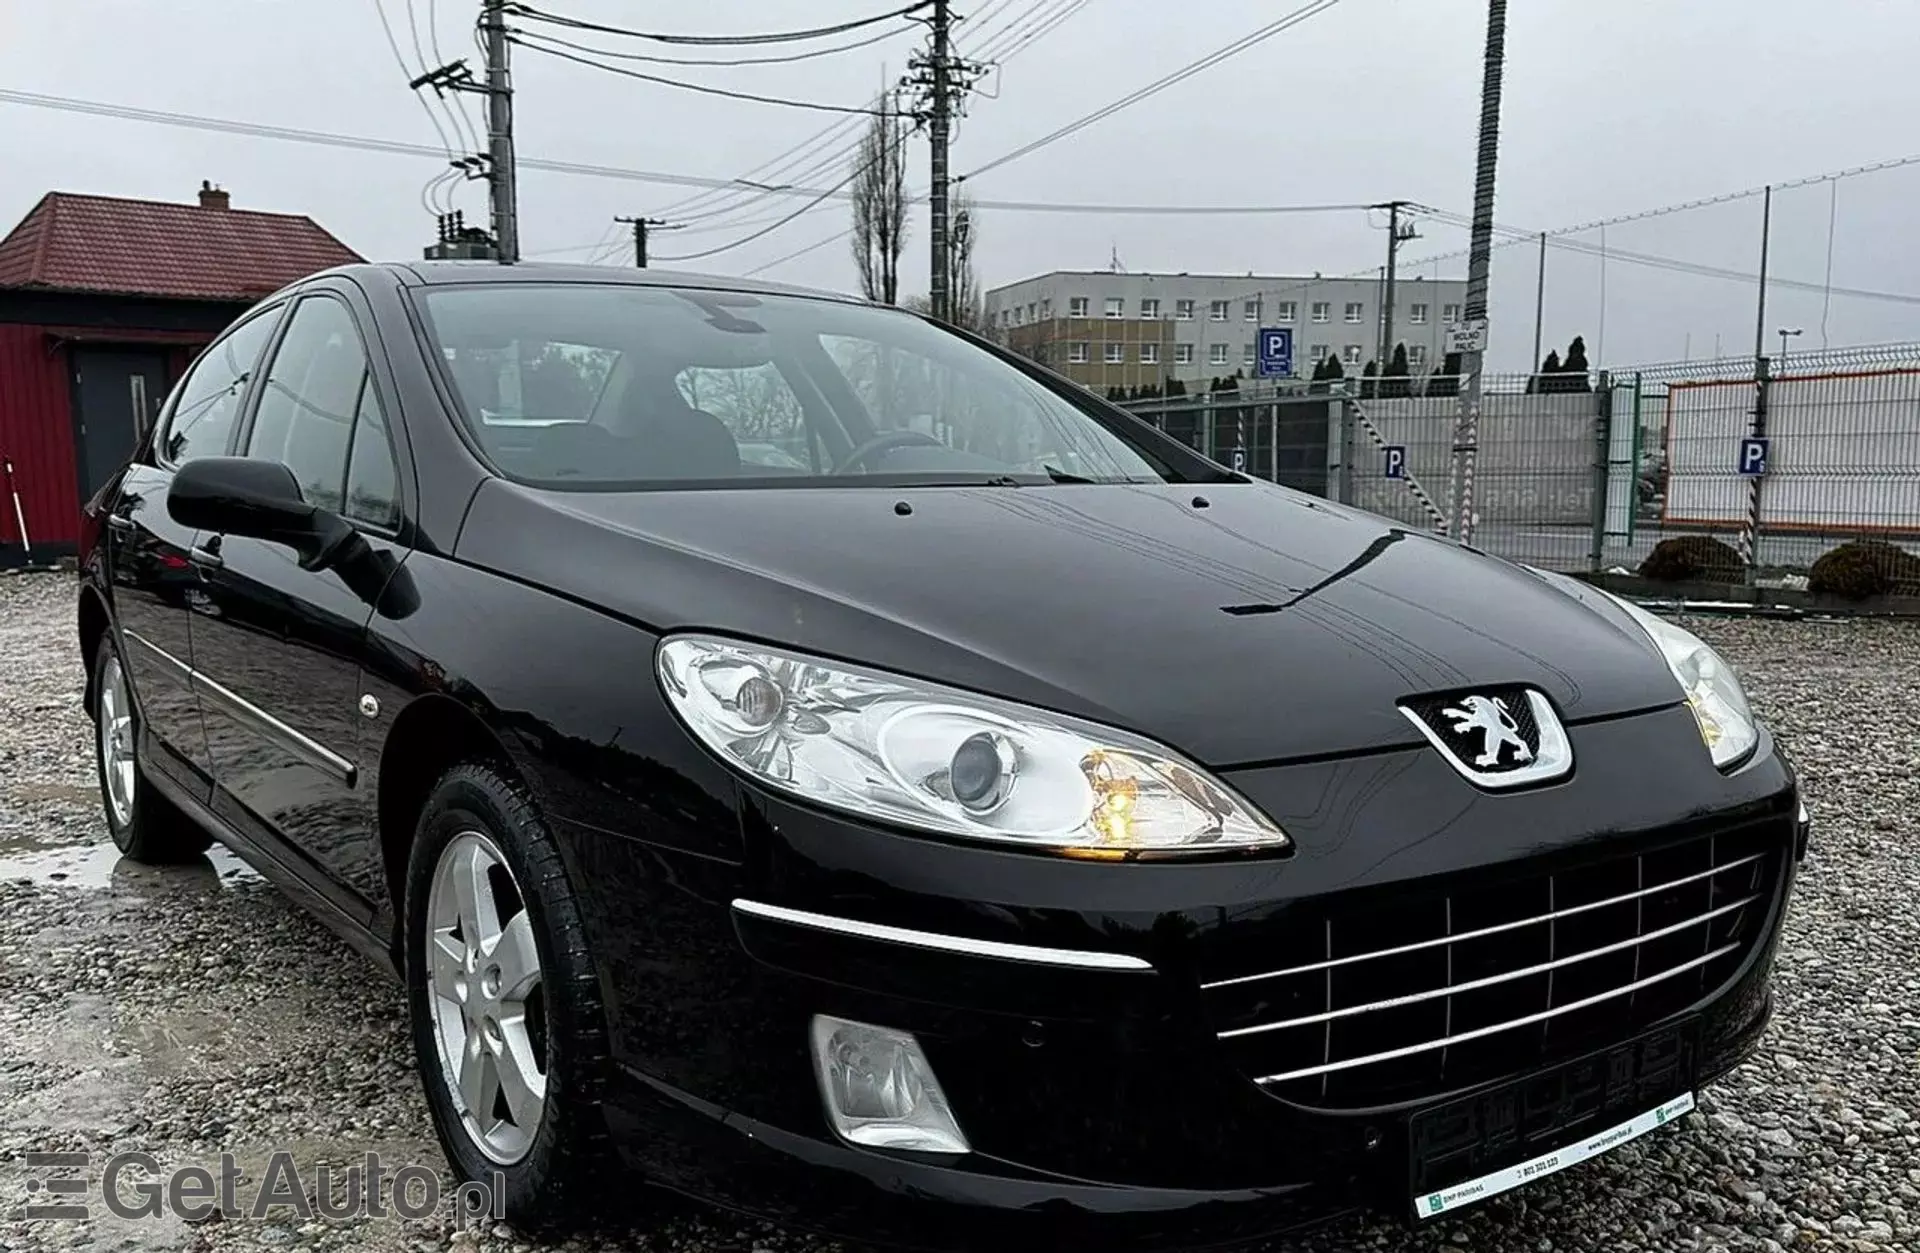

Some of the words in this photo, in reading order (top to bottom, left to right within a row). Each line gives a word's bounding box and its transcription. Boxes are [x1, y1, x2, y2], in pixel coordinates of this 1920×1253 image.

[1269, 336, 1283, 355] P
[1234, 453, 1244, 472] P
[1388, 450, 1402, 474] P
[1745, 444, 1764, 470] P
